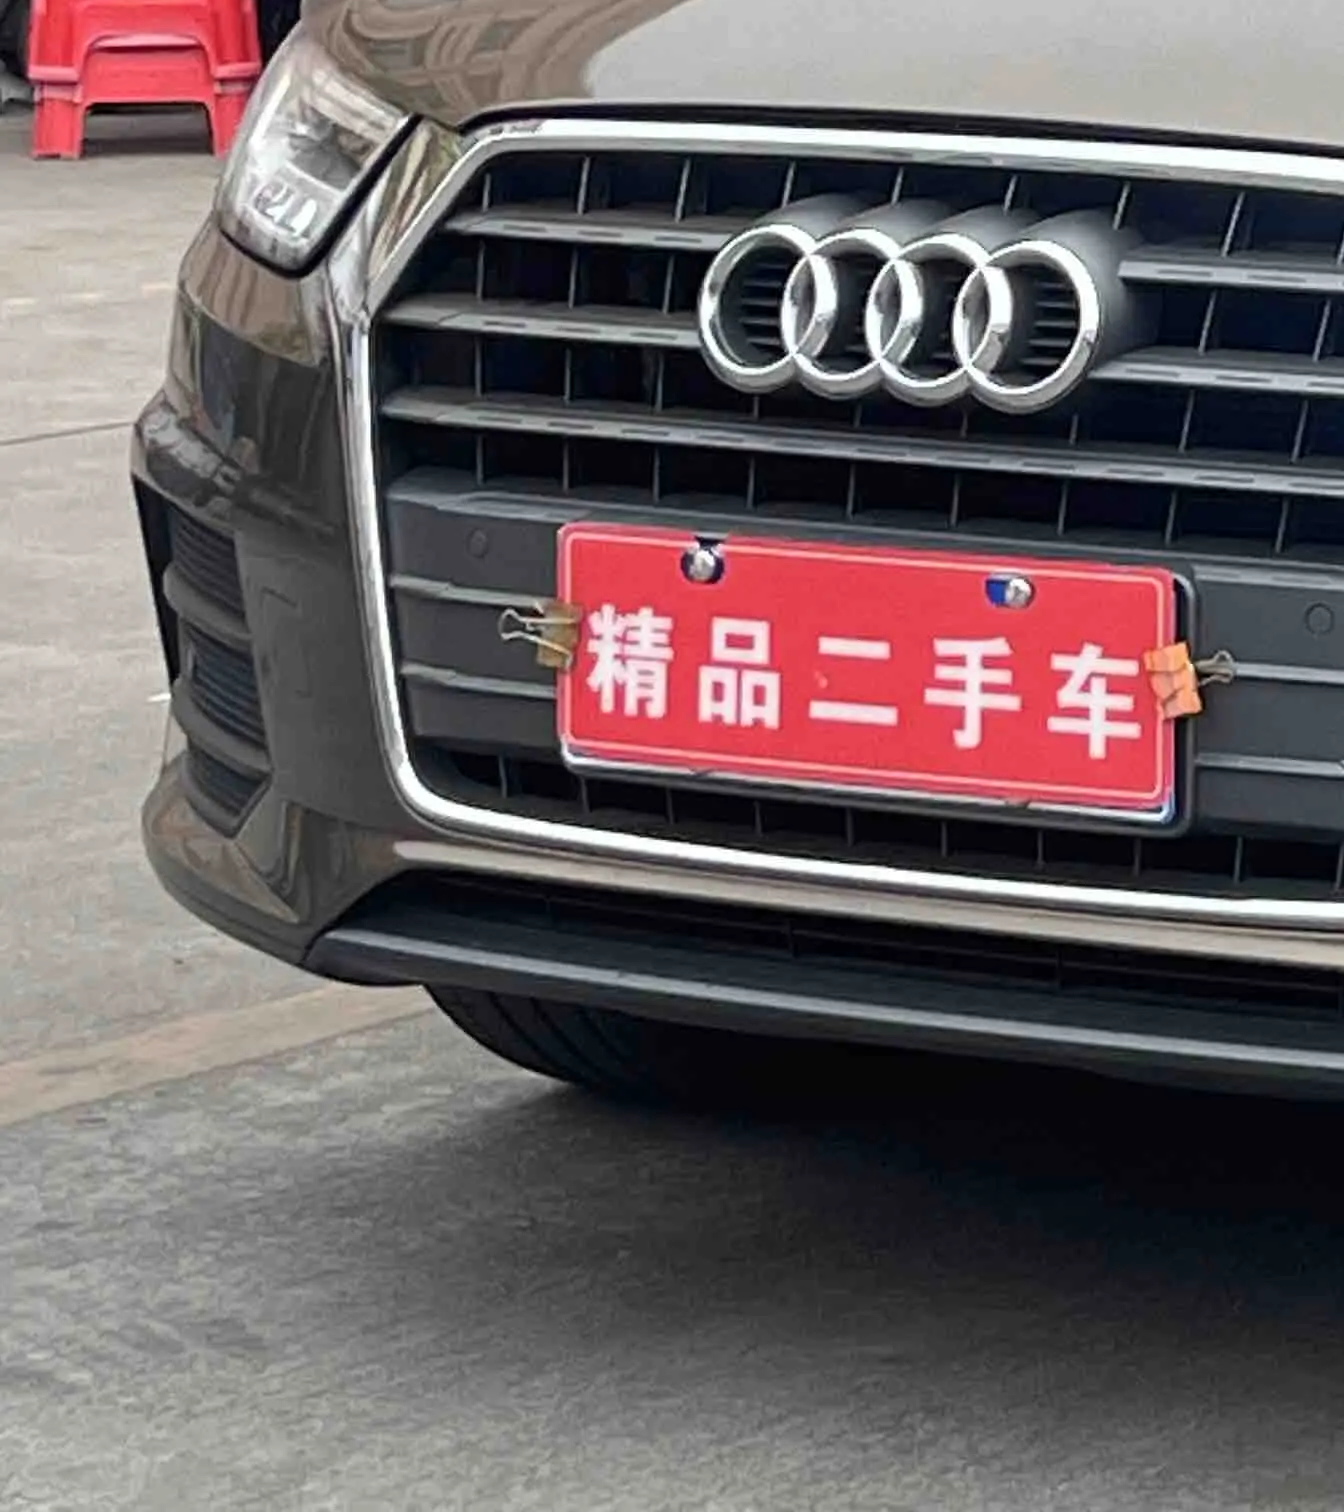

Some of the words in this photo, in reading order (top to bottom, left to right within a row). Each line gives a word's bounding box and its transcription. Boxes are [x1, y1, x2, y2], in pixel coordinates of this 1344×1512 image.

[587, 602, 1142, 759] 精品二手车
